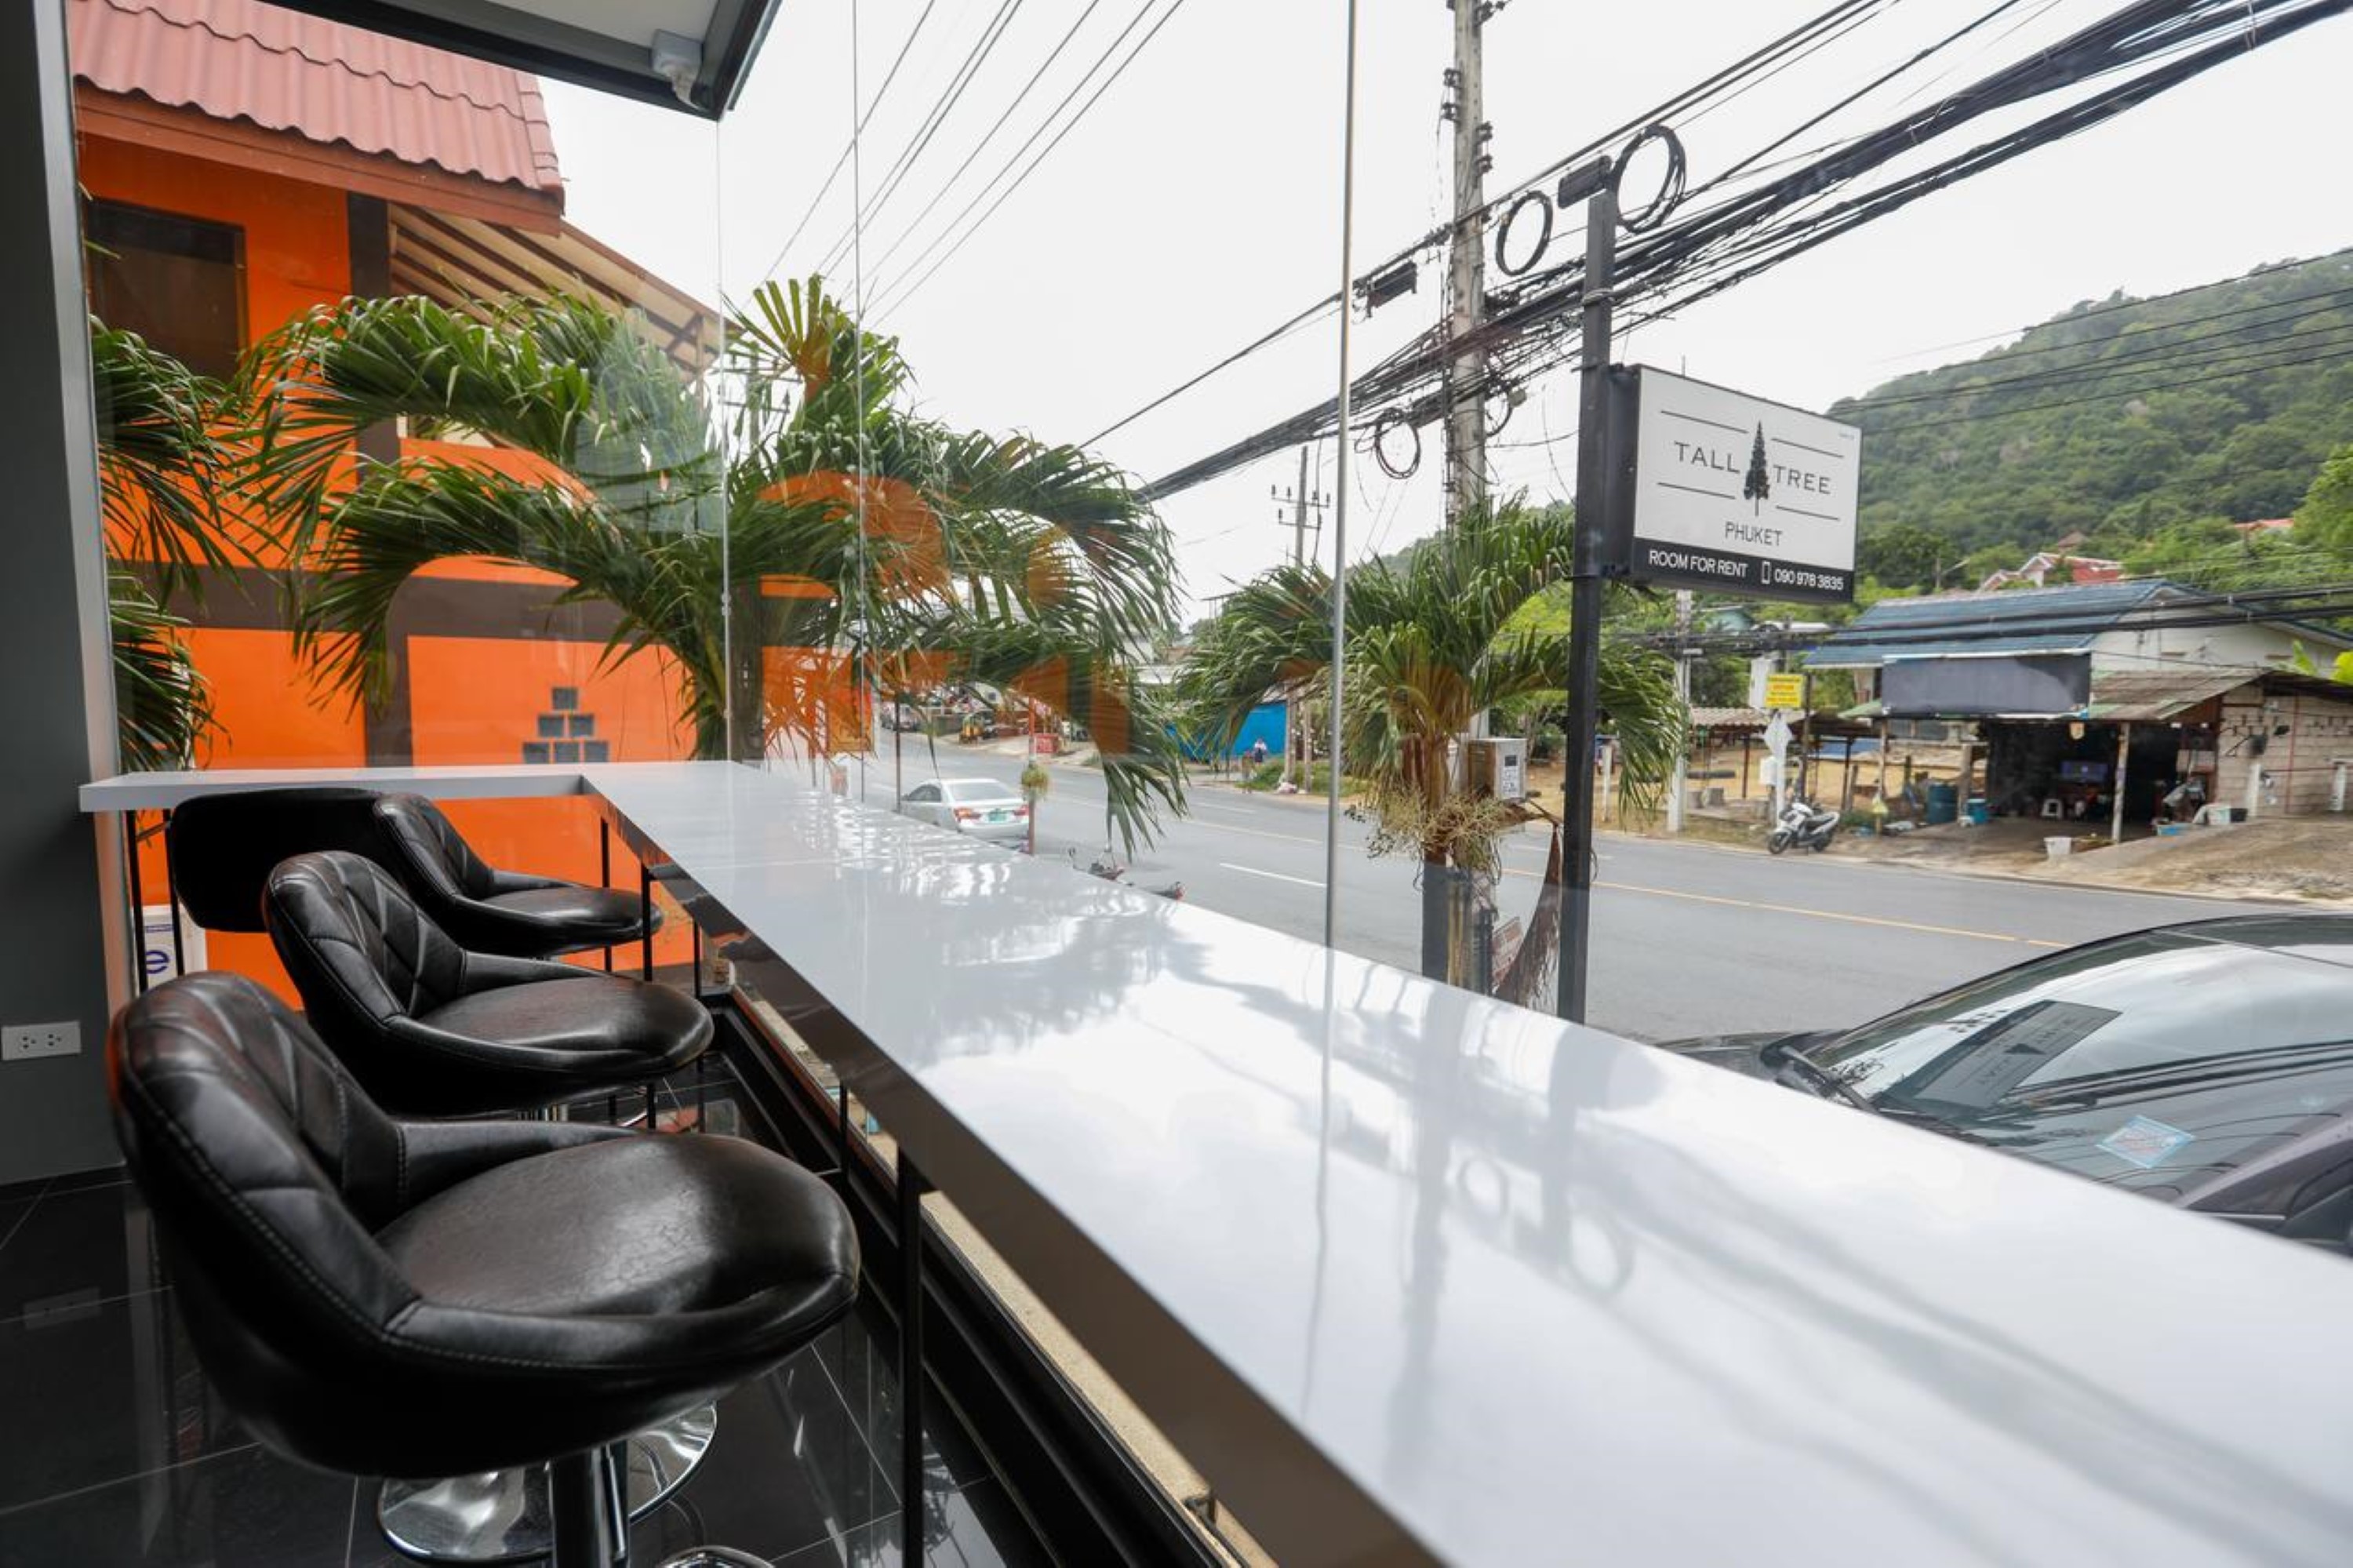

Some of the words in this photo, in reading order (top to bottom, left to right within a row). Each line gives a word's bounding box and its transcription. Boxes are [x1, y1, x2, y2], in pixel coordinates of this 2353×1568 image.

[1674, 440, 1740, 474] TALL
[1773, 464, 1831, 495] TREE
[1726, 521, 1783, 547] PHUKET
[1649, 550, 1687, 570] ROOM
[1690, 555, 1715, 574] FOR
[1718, 558, 1748, 578] RENT
[1774, 569, 1795, 584] 090
